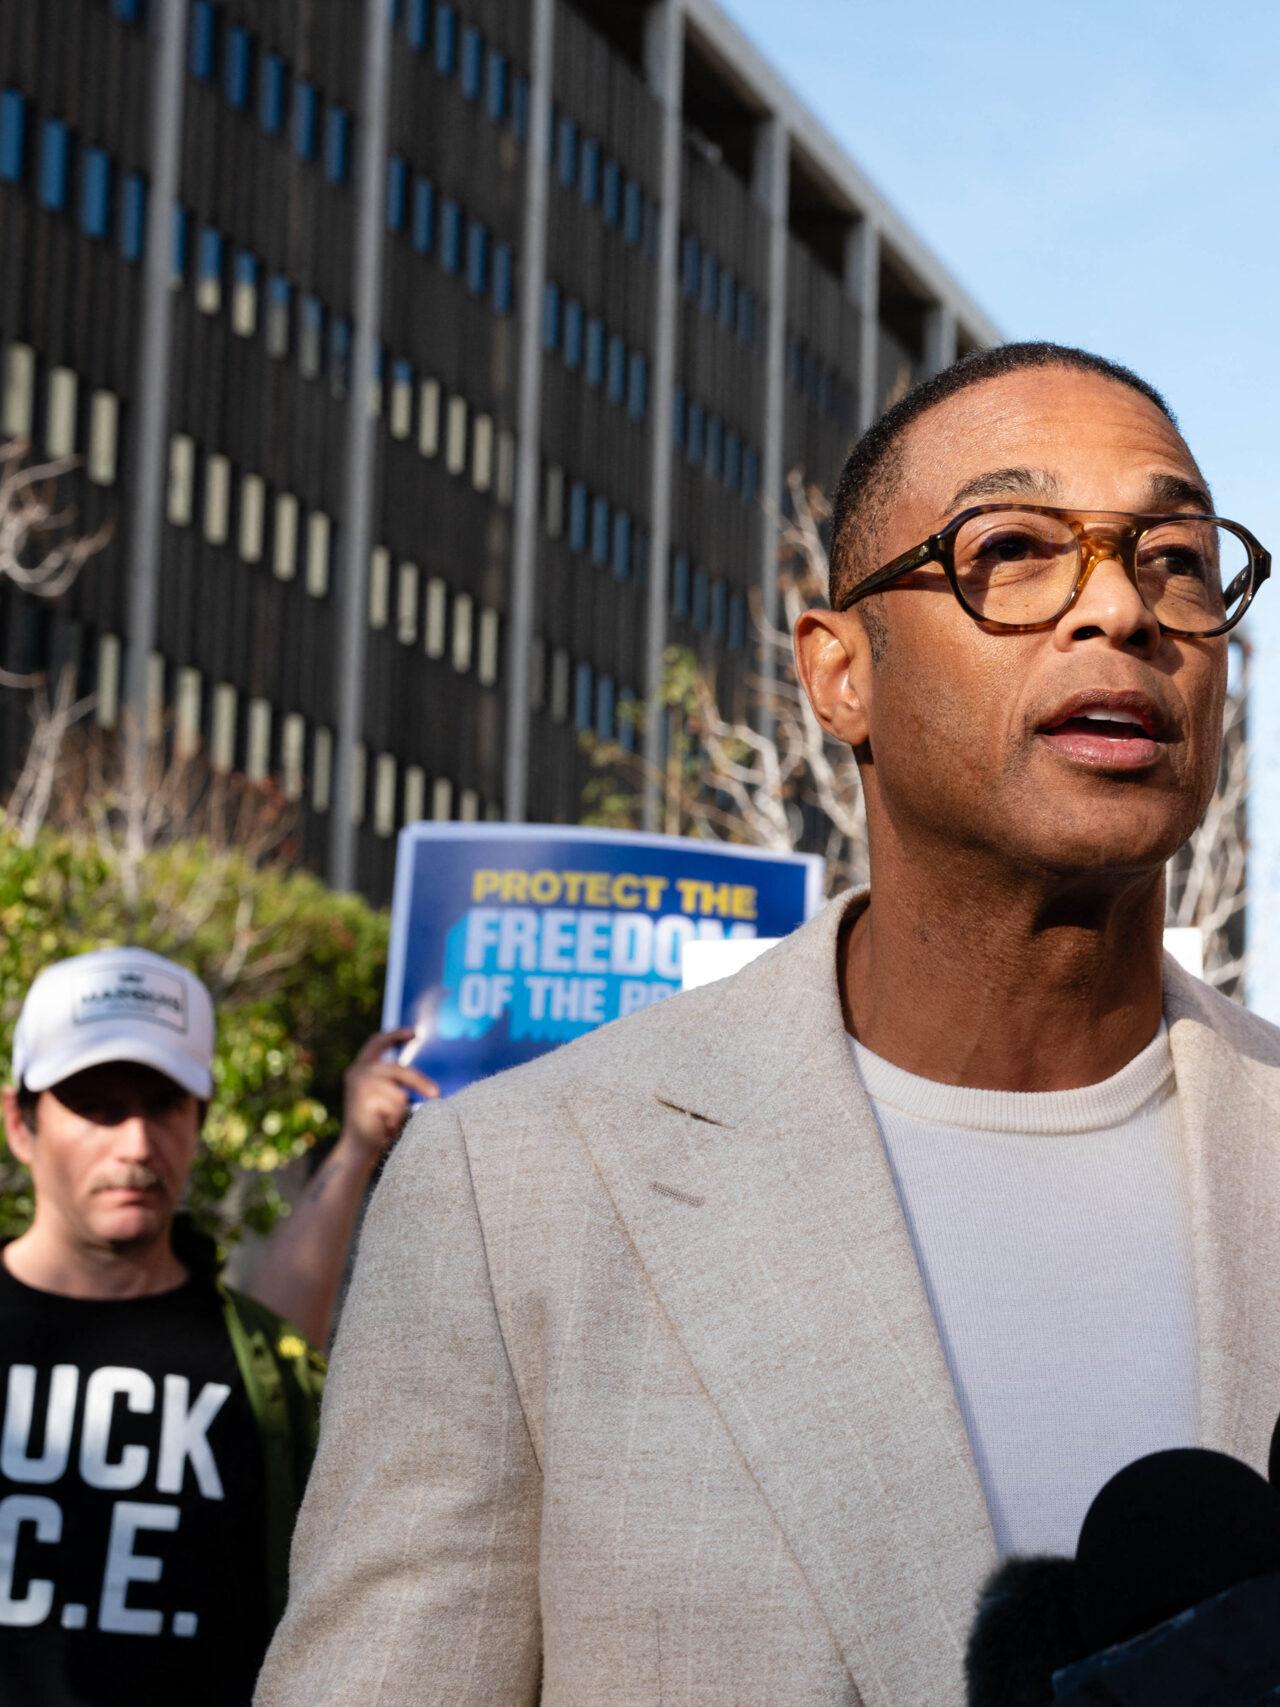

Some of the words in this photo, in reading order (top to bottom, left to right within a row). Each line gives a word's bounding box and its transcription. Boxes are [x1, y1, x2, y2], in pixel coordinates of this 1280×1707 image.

[473, 870, 668, 910] PROTECT
[678, 879, 758, 919] THE
[465, 908, 757, 979] FREEDO
[459, 974, 515, 1020] OF
[524, 976, 608, 1023] THE
[0, 1364, 232, 1501] UCK
